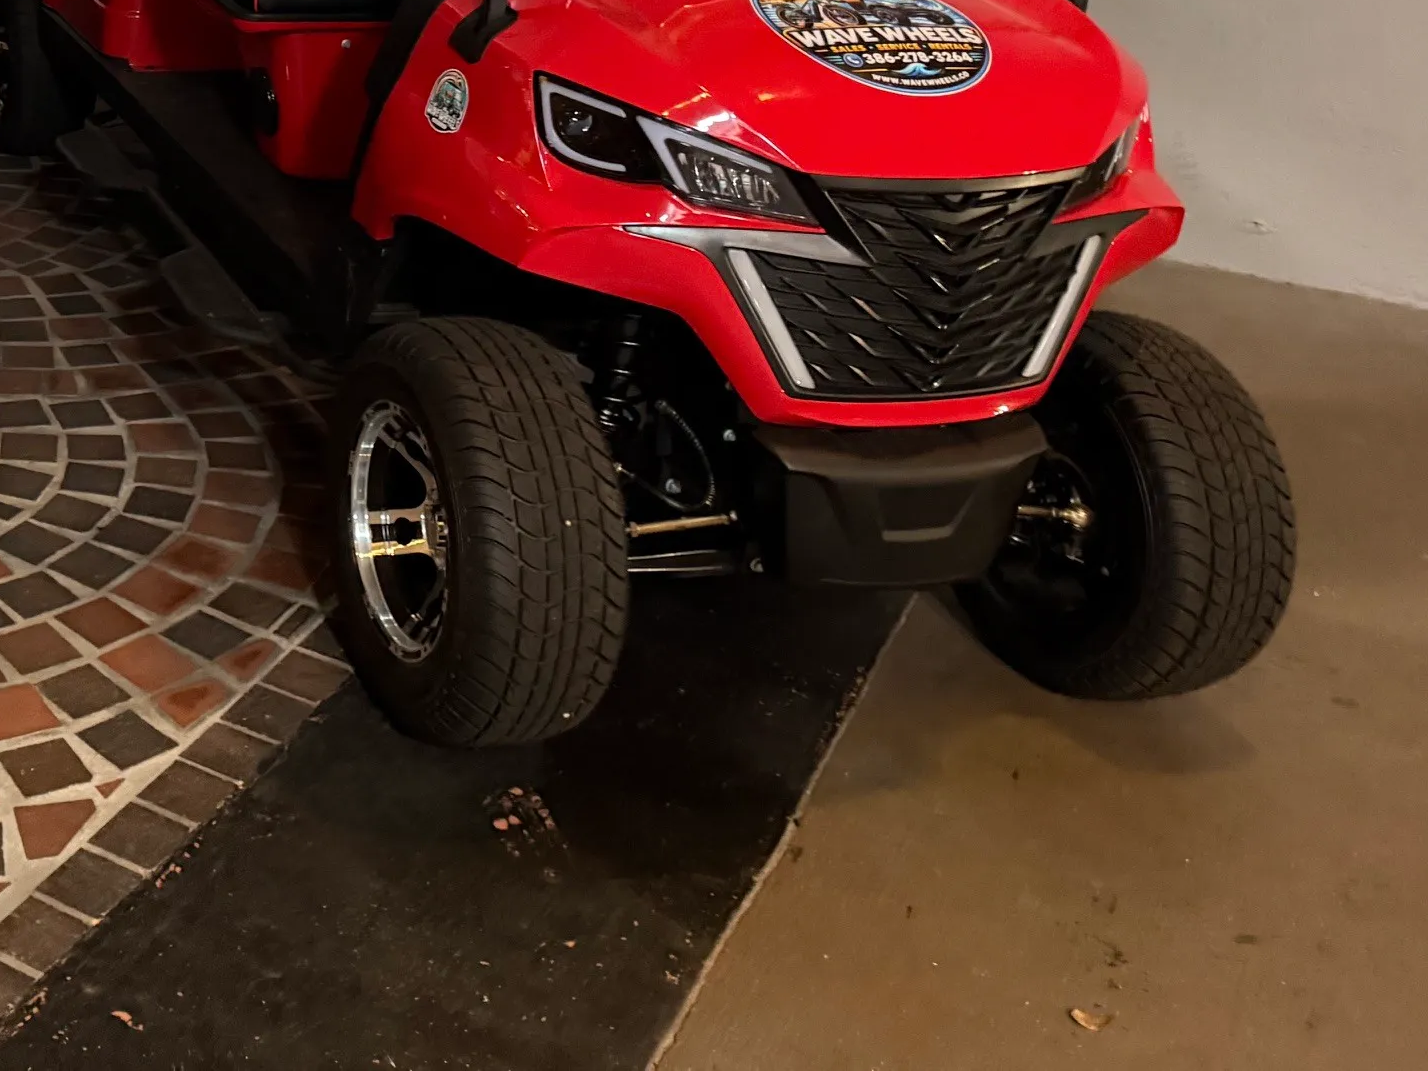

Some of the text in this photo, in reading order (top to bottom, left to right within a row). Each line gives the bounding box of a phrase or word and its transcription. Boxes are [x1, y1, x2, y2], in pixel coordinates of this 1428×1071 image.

[789, 26, 983, 48] WAVE WHEELS
[831, 42, 972, 53] SALES SERVICE RENTALS
[863, 52, 973, 64] 386-278-3264
[871, 71, 970, 86] WWW.WAVEWHEELS.CO
